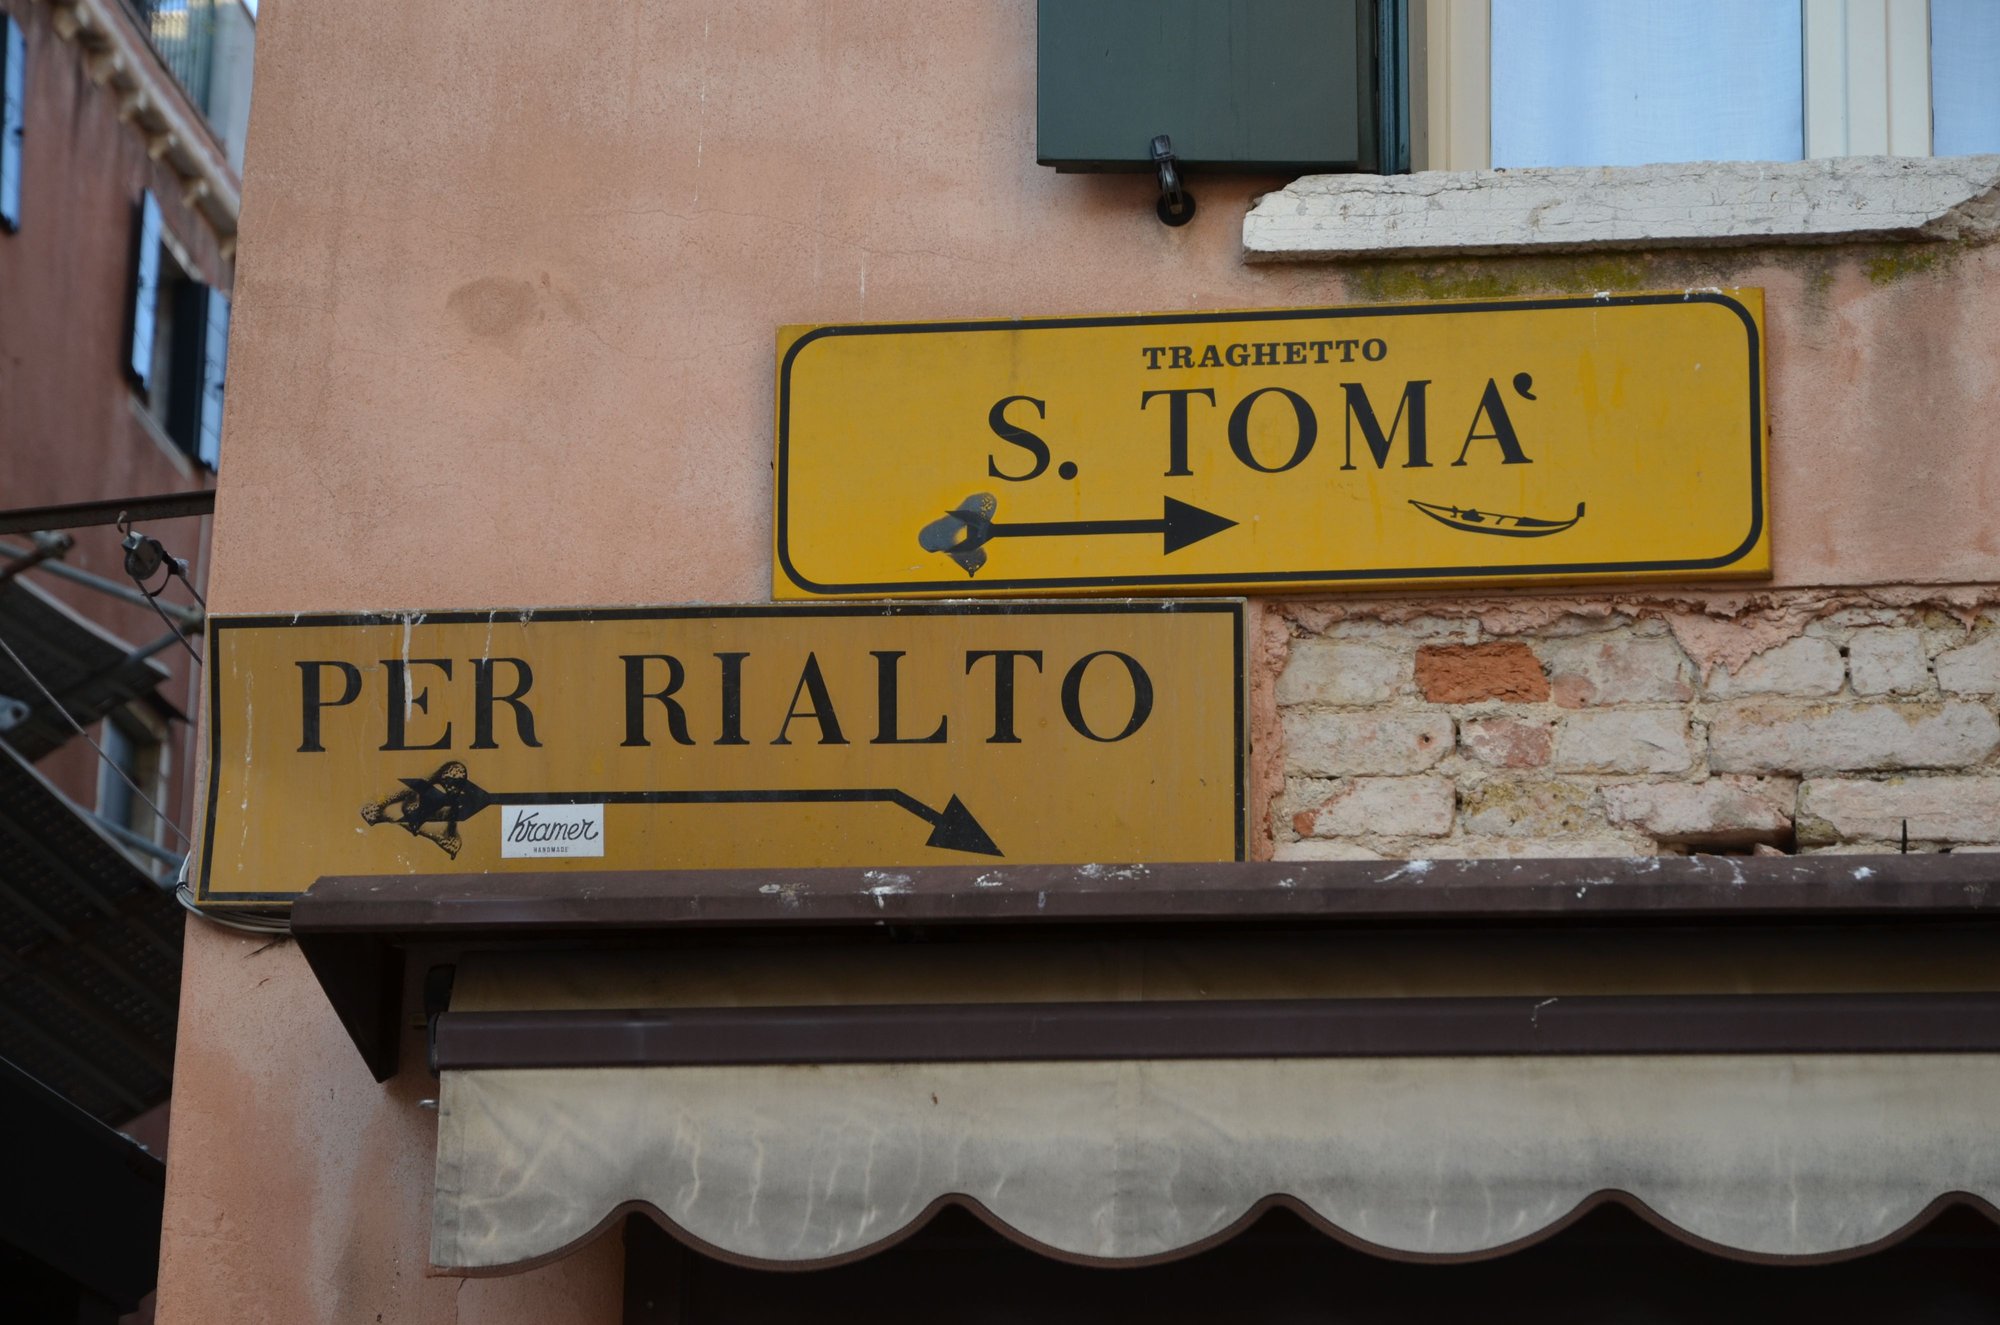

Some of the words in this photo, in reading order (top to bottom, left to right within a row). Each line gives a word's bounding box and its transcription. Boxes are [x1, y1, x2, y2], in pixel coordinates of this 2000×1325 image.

[1142, 338, 1388, 370] TRAGHETTO
[988, 395, 1079, 482] S.
[294, 657, 543, 753] PER
[618, 649, 1154, 747] RIALTO
[507, 809, 599, 843] Kramer
[533, 845, 569, 854] HANDMADE
